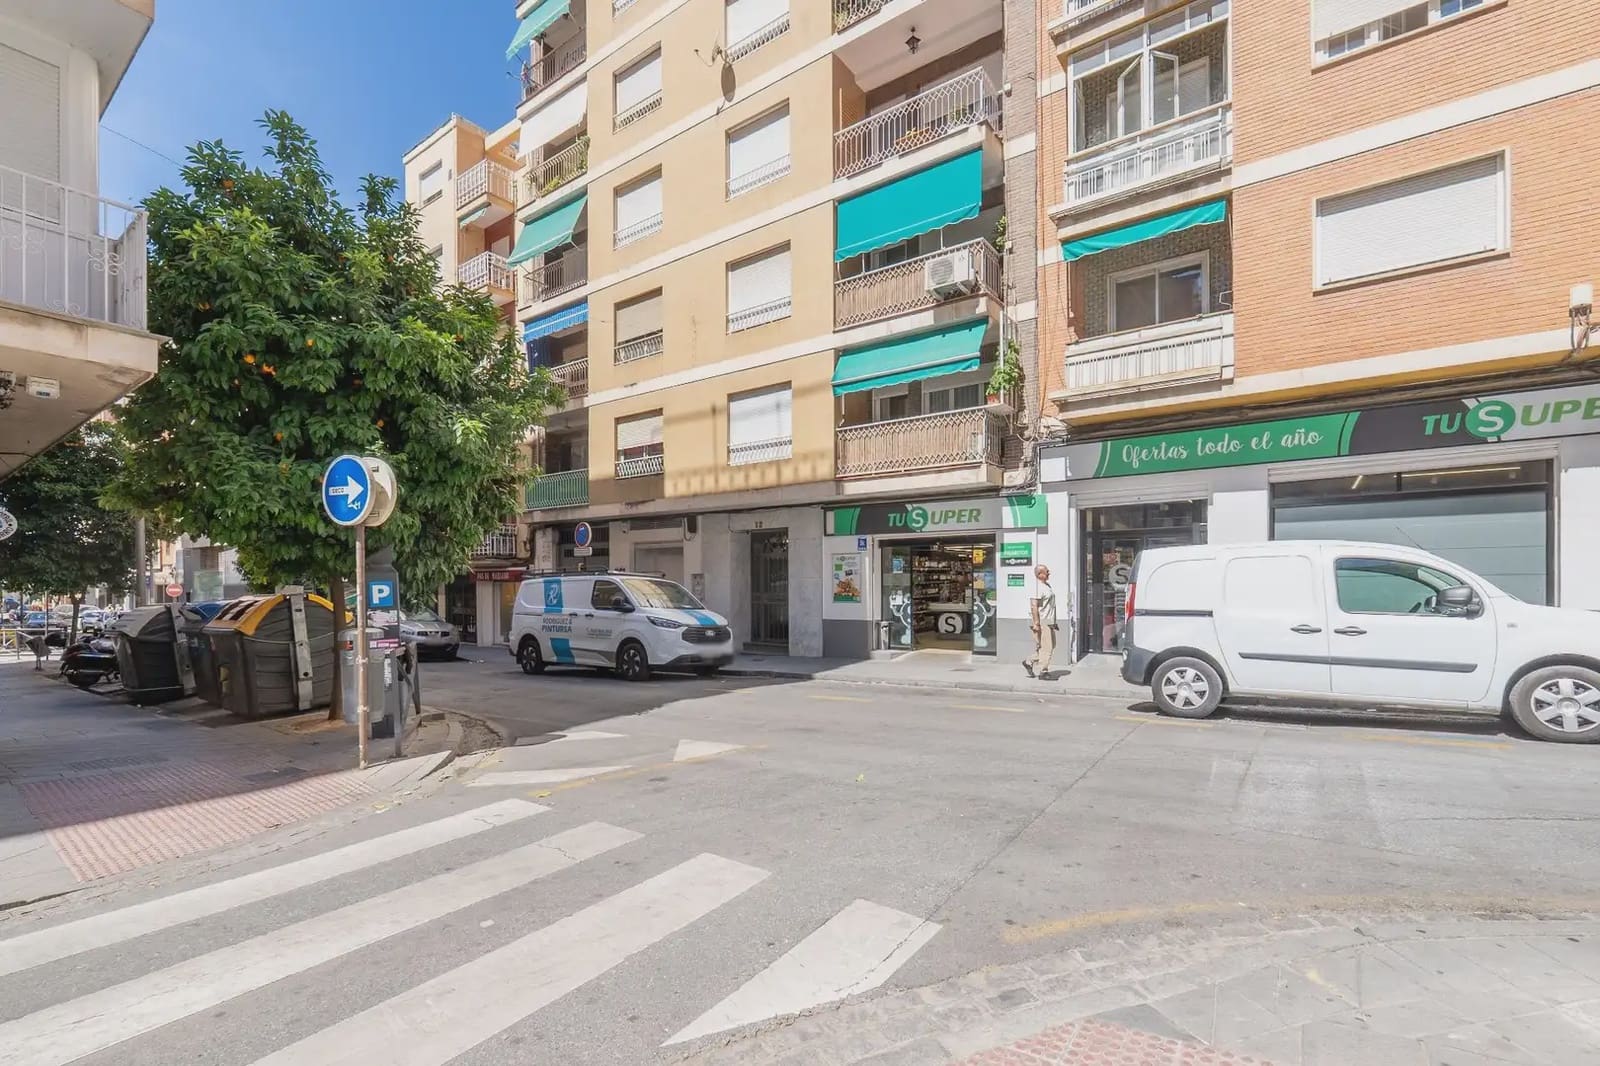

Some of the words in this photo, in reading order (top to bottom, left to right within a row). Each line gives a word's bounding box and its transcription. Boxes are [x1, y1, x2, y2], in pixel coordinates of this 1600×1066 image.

[1122, 442, 1189, 469] Ofertas
[1197, 433, 1244, 456] todo
[1251, 432, 1273, 450] el
[1281, 428, 1324, 448] año
[372, 584, 390, 604] P
[944, 617, 957, 634] S
